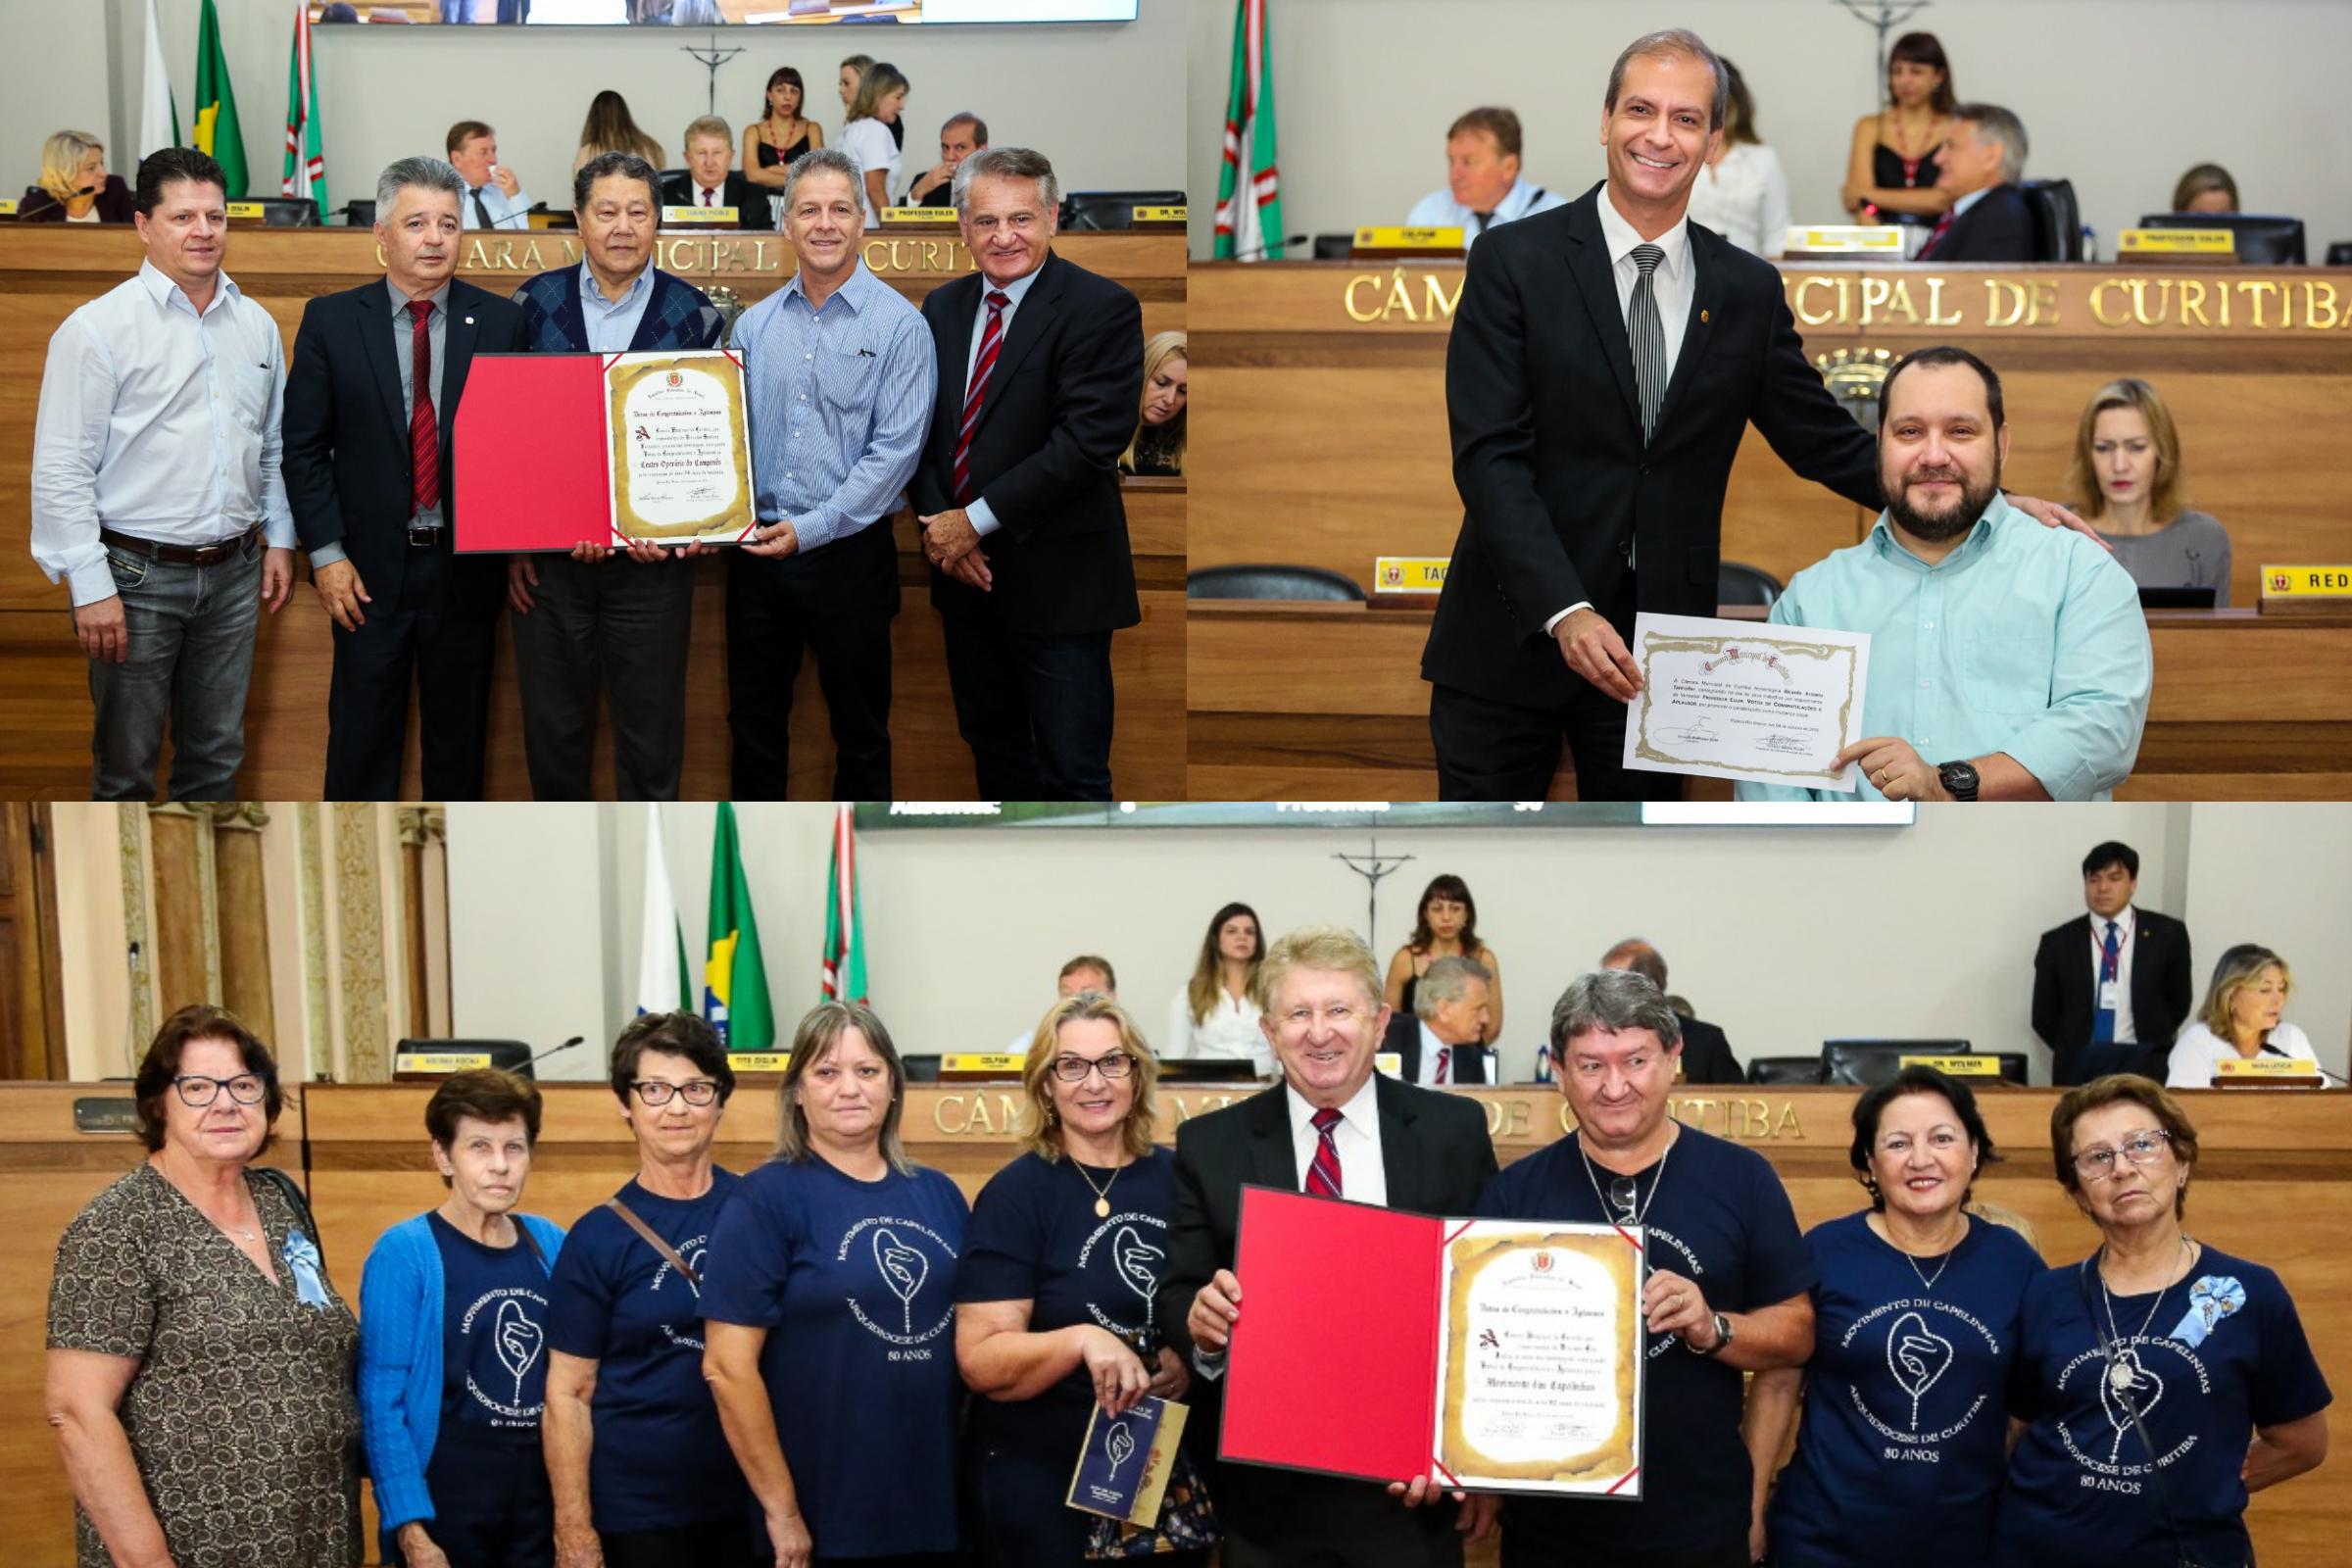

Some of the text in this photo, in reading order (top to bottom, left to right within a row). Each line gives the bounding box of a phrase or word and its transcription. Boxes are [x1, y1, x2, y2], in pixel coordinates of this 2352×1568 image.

[1345, 266, 1467, 322] CÂM
[1984, 278, 2061, 327] DE
[1840, 1298, 1911, 1348] MOVIMENTO
[1933, 1300, 2000, 1354] CAPELINHAS
[903, 1348, 933, 1361] ANOS
[2151, 1336, 2212, 1395] CAPELINHAS
[1850, 1384, 1919, 1445] ARQUIDIOCESE
[1921, 1432, 1939, 1445] DE
[1884, 1446, 1940, 1463] 80 ANOS
[2122, 1464, 2141, 1477] DE
[2080, 1474, 2142, 1495] 80 ANOS
